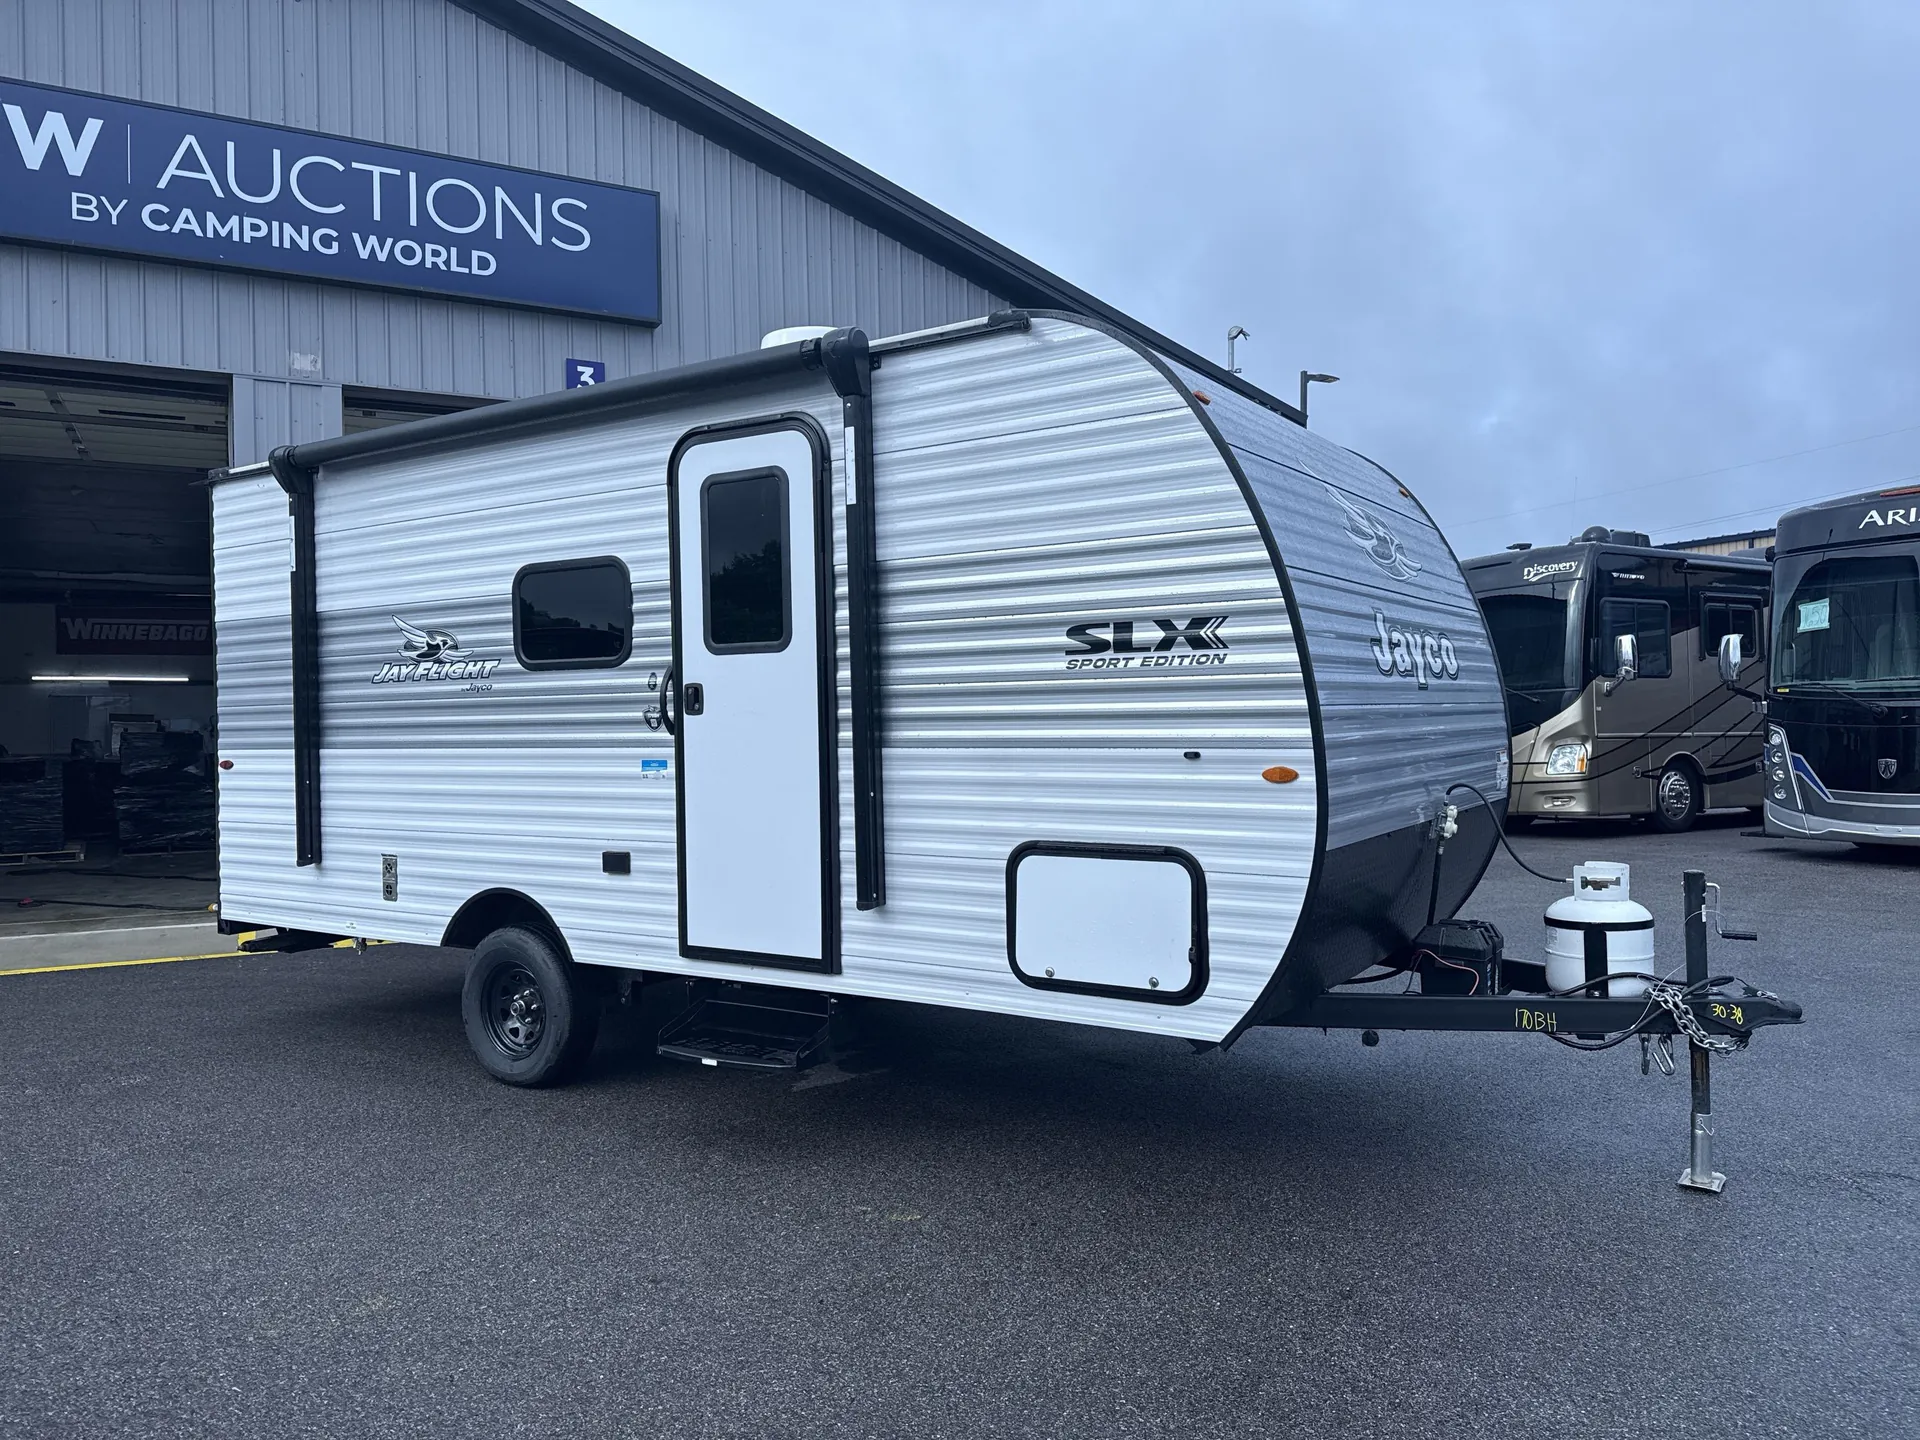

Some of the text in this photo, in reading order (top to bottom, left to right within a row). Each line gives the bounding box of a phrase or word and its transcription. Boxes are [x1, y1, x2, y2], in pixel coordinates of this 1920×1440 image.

[156, 134, 591, 252] AUCTIONS
[71, 191, 497, 276] BY CAMPING WORLD
[576, 365, 596, 389] 3
[1858, 507, 1920, 529] ARI
[1523, 560, 1578, 581] Discovery
[1064, 615, 1229, 656] SLX
[1370, 606, 1460, 690] Jayco
[1065, 653, 1228, 670] SPORT EDITION
[465, 682, 493, 693] Jayco
